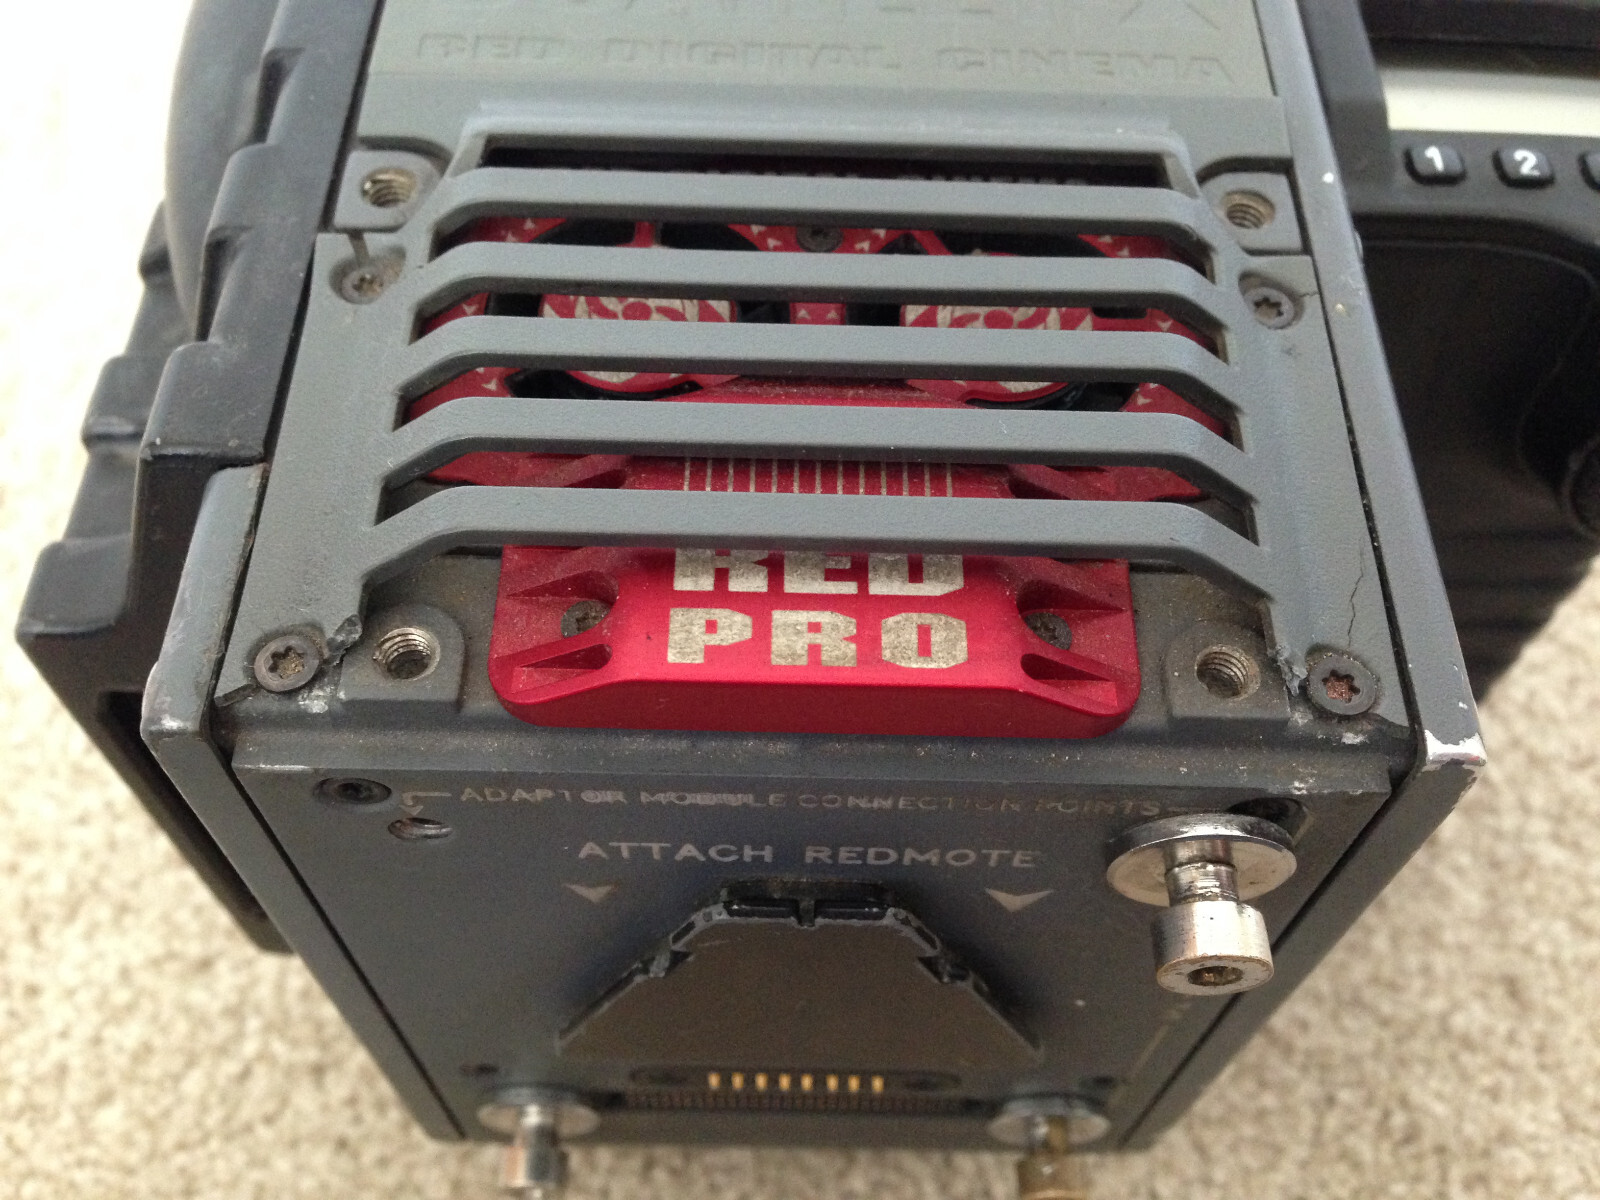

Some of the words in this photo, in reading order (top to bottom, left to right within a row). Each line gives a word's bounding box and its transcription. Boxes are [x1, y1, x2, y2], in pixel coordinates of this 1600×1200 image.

[1424, 145, 1445, 172] 1
[1513, 149, 1541, 176] 2
[673, 548, 965, 596] RED
[667, 607, 969, 669] PRO
[578, 841, 774, 863] ATTACH
[804, 845, 1039, 869] REDMOTE
